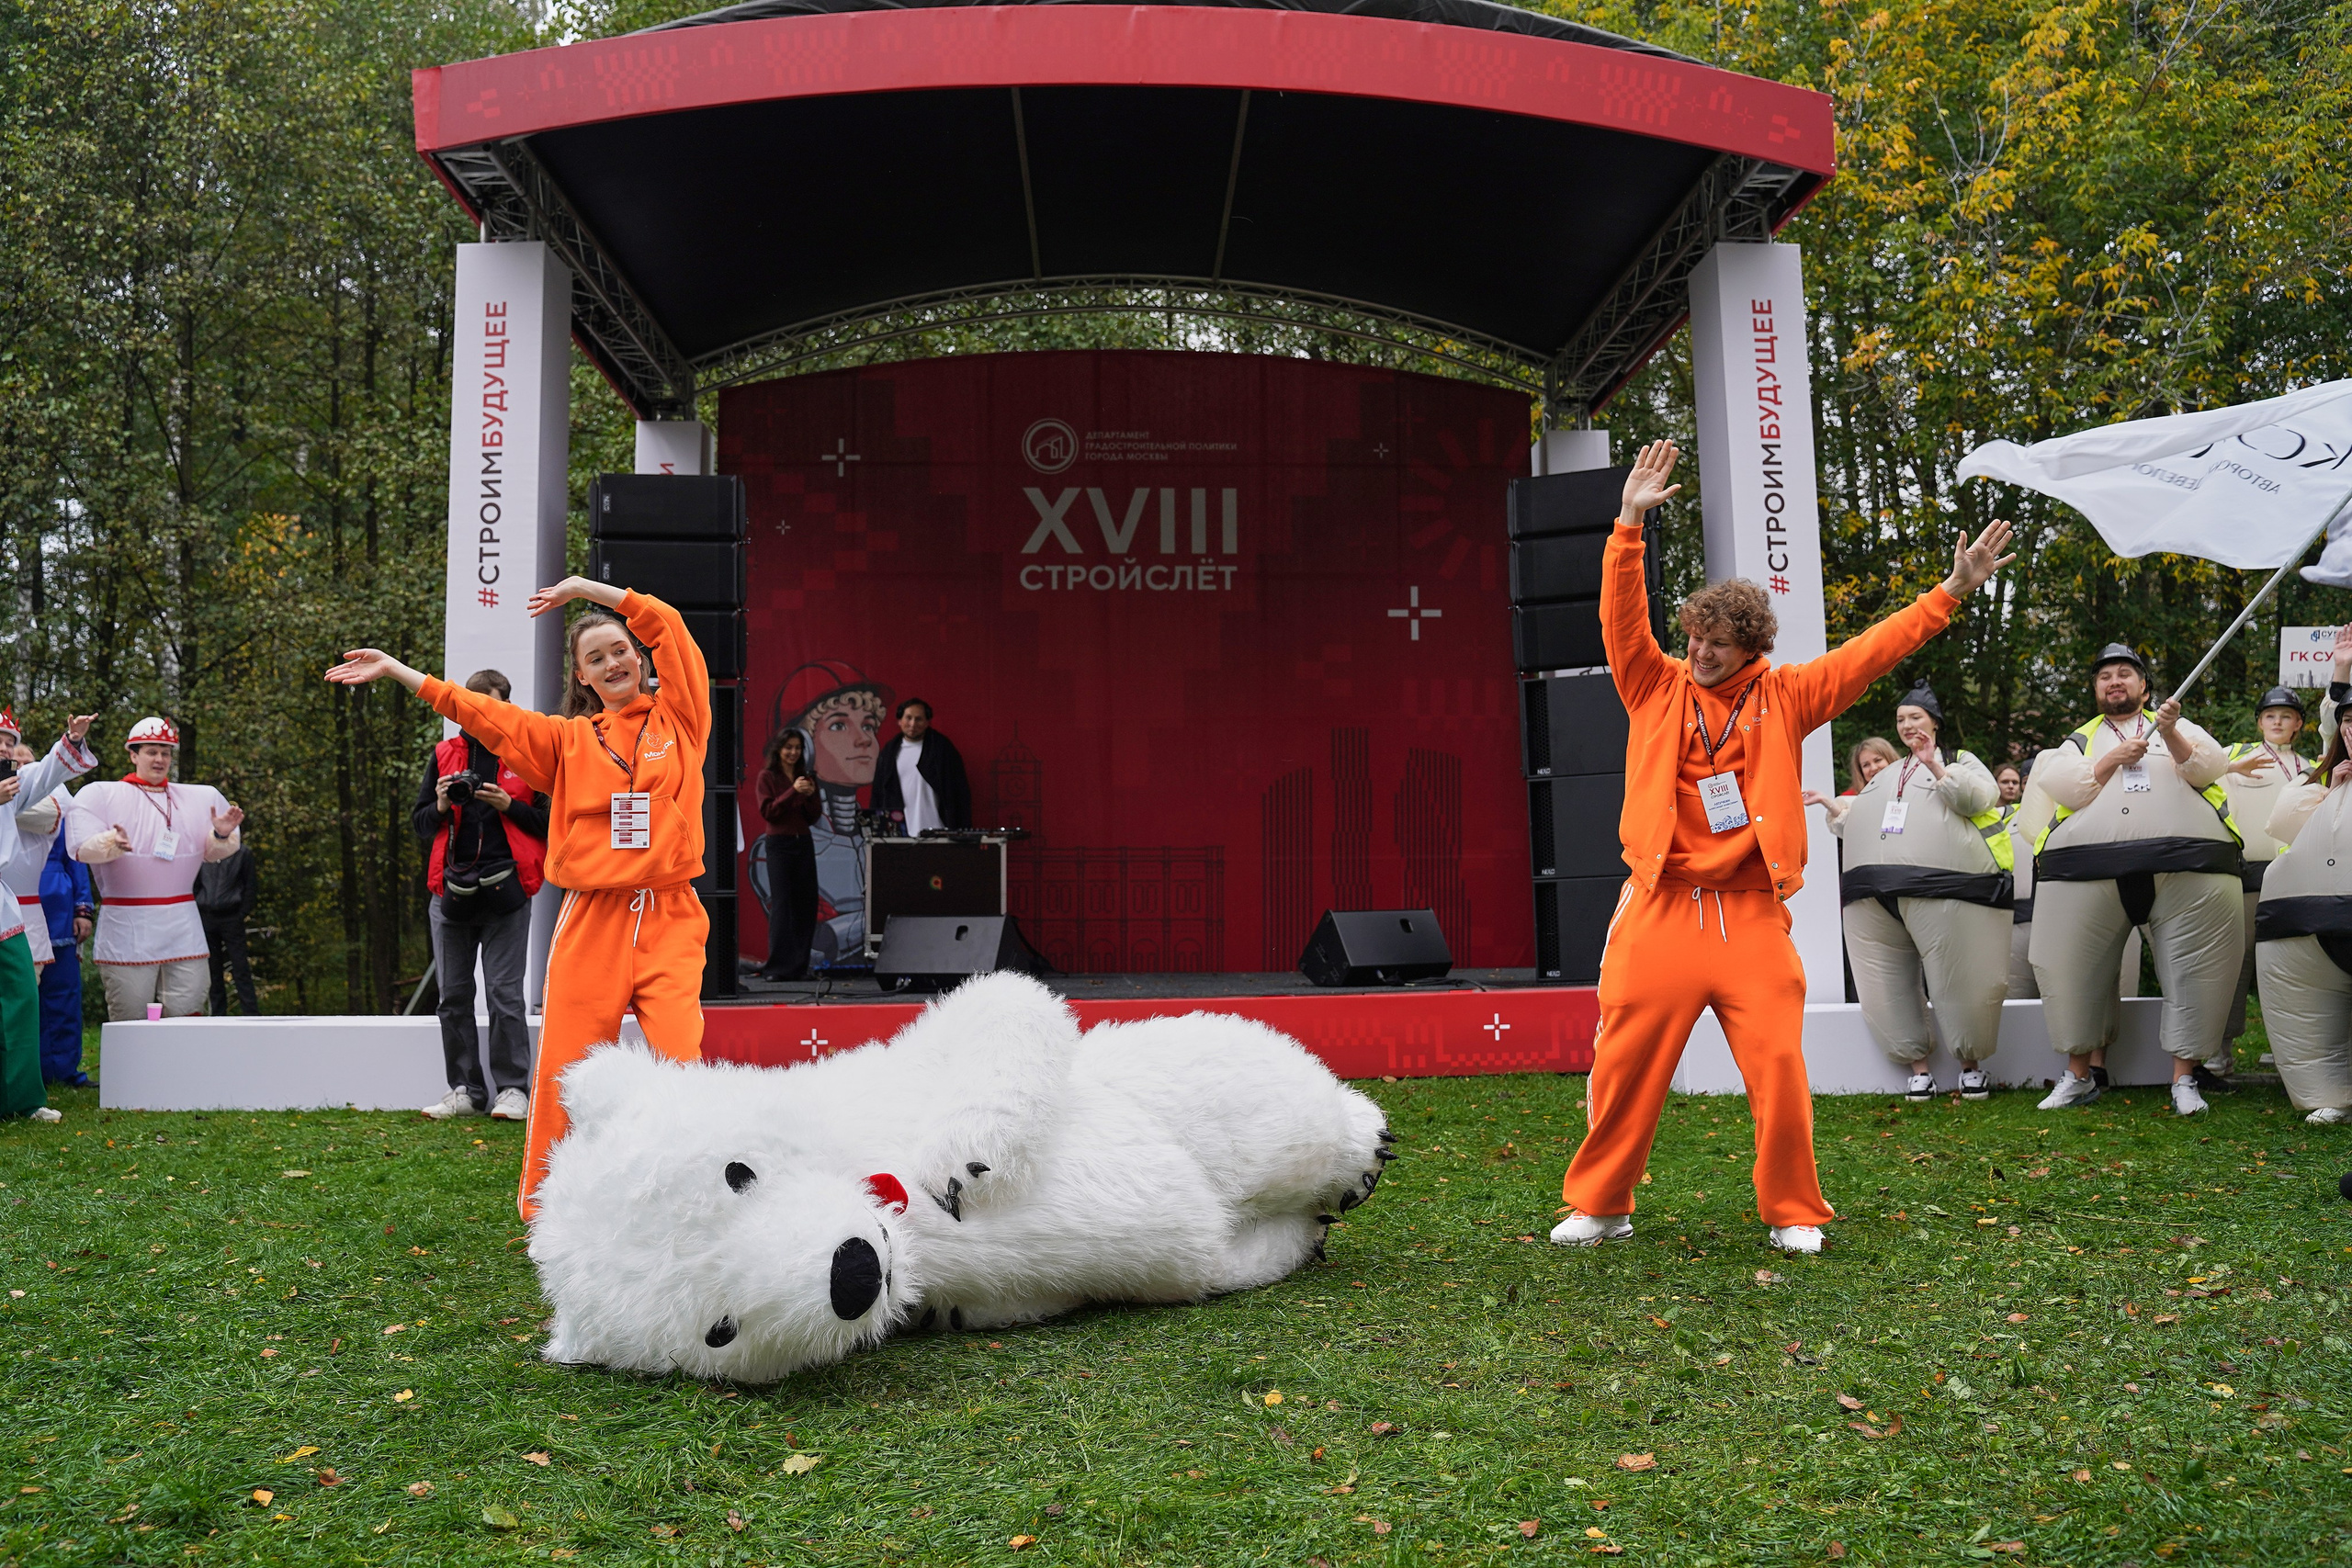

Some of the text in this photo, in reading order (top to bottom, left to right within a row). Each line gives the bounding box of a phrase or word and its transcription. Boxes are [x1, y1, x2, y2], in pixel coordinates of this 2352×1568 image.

[1085, 431, 1149, 440] ДЕПАРТАМЕНТ
[1085, 441, 1238, 450] ГРАДОСТРОИТЕЛЬНОЙ ПОЛИТИКИ
[1751, 299, 1790, 595] #СТРОИМБУДУЩЕЕ
[478, 300, 510, 608] #СТРОИМБУДУЩЕЕ
[1085, 452, 1169, 461] ГОРОДА МОСКВЫ
[1021, 487, 1238, 554] XVIII
[1020, 557, 1238, 591] СТРОЙСЛЁТ
[2290, 650, 2335, 662] ГК СУ
[1709, 784, 1729, 795] XVIII
